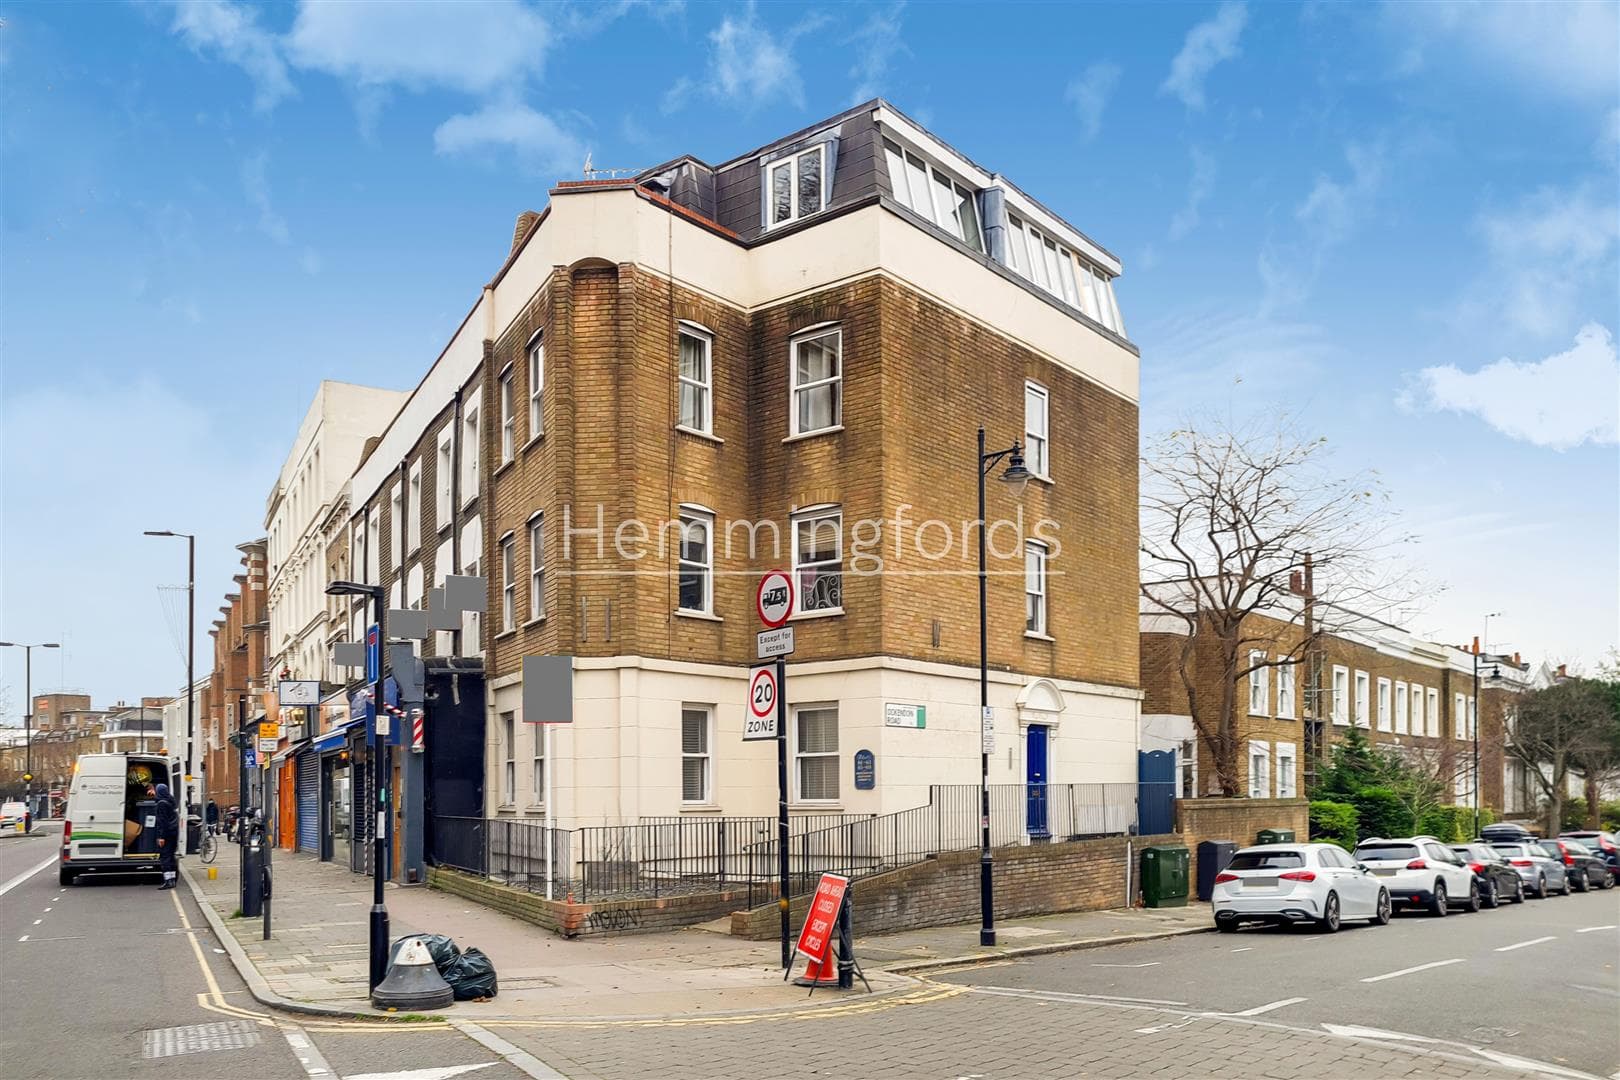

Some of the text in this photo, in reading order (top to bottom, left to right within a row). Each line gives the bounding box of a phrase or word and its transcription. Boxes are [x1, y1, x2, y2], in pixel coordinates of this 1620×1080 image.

[760, 631, 791, 645] Except for
[765, 643, 786, 653] access
[755, 683, 773, 703] 20
[748, 720, 774, 733] ZONE
